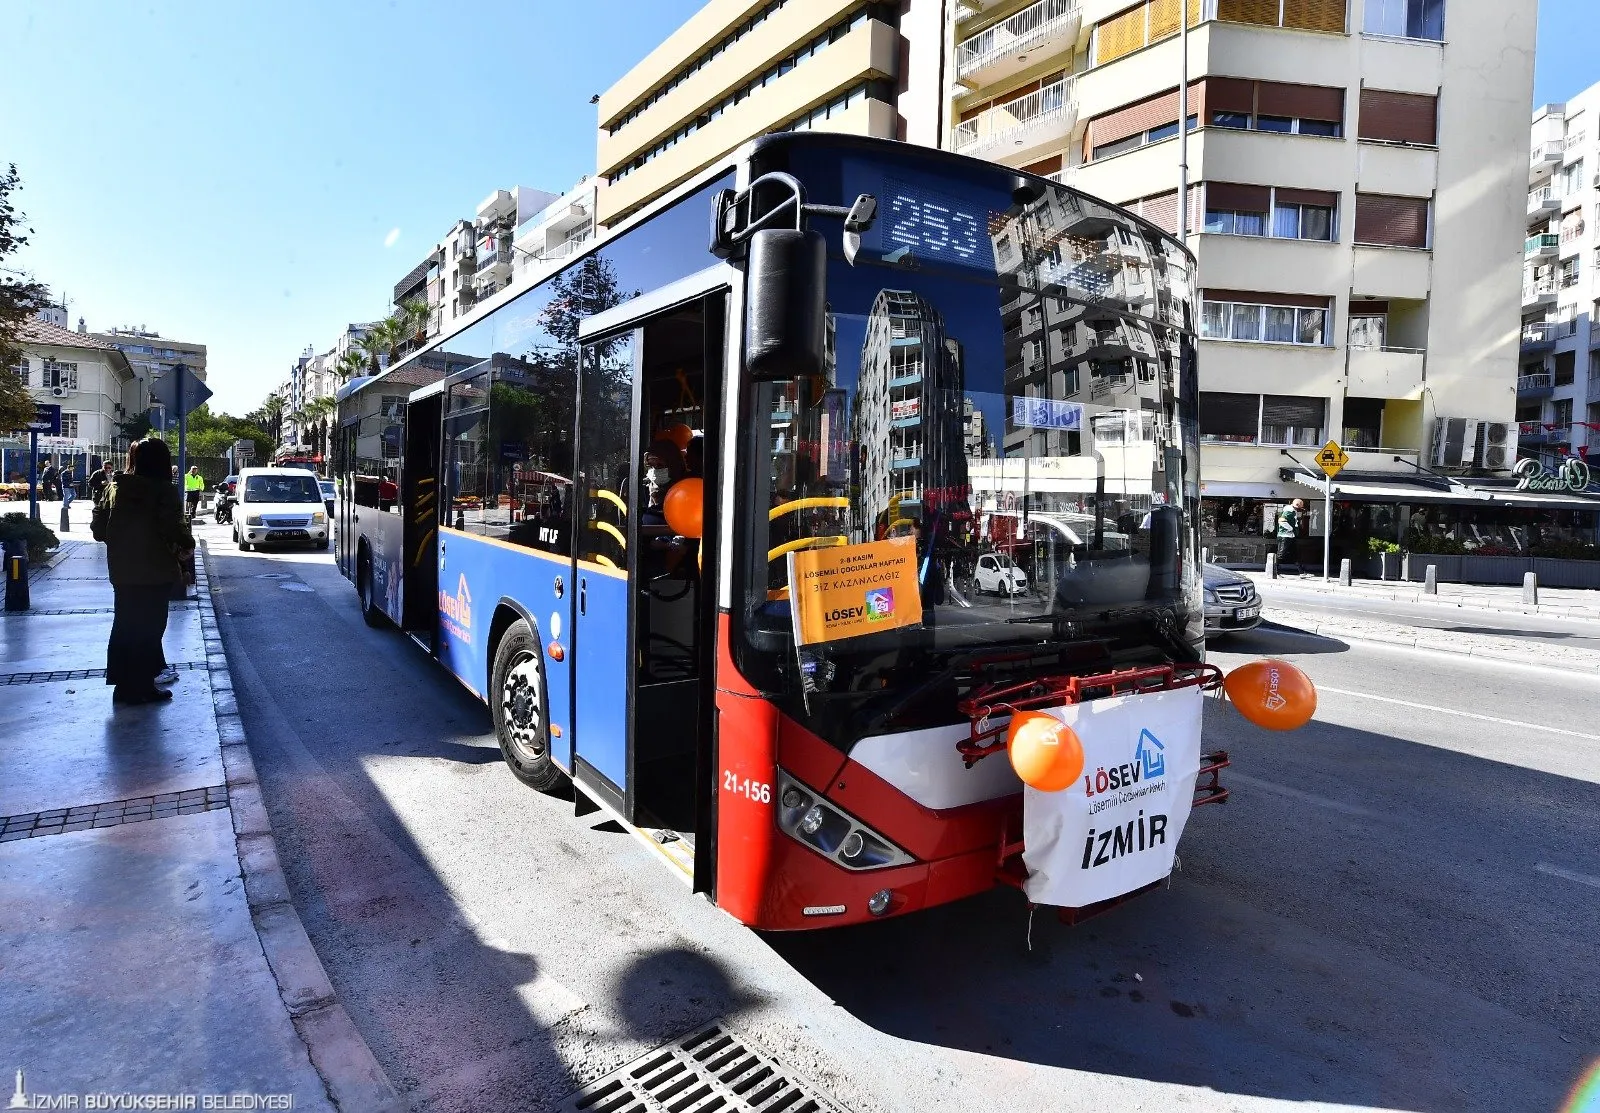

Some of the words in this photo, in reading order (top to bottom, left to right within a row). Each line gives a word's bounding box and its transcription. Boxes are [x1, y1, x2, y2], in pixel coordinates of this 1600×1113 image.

[892, 196, 977, 258] 253
[549, 529, 559, 544] LF
[840, 562, 878, 574] ÇOCUKLAR
[879, 557, 906, 568] HAFTASI
[852, 553, 874, 563] KASIM
[825, 606, 864, 622] LÖSEV
[1270, 668, 1279, 696] LÖSEV
[724, 769, 771, 804] 21-156
[1085, 761, 1140, 797] LÖSEV
[1089, 795, 1118, 815] Lösemili
[1081, 809, 1168, 870] İZMİR
